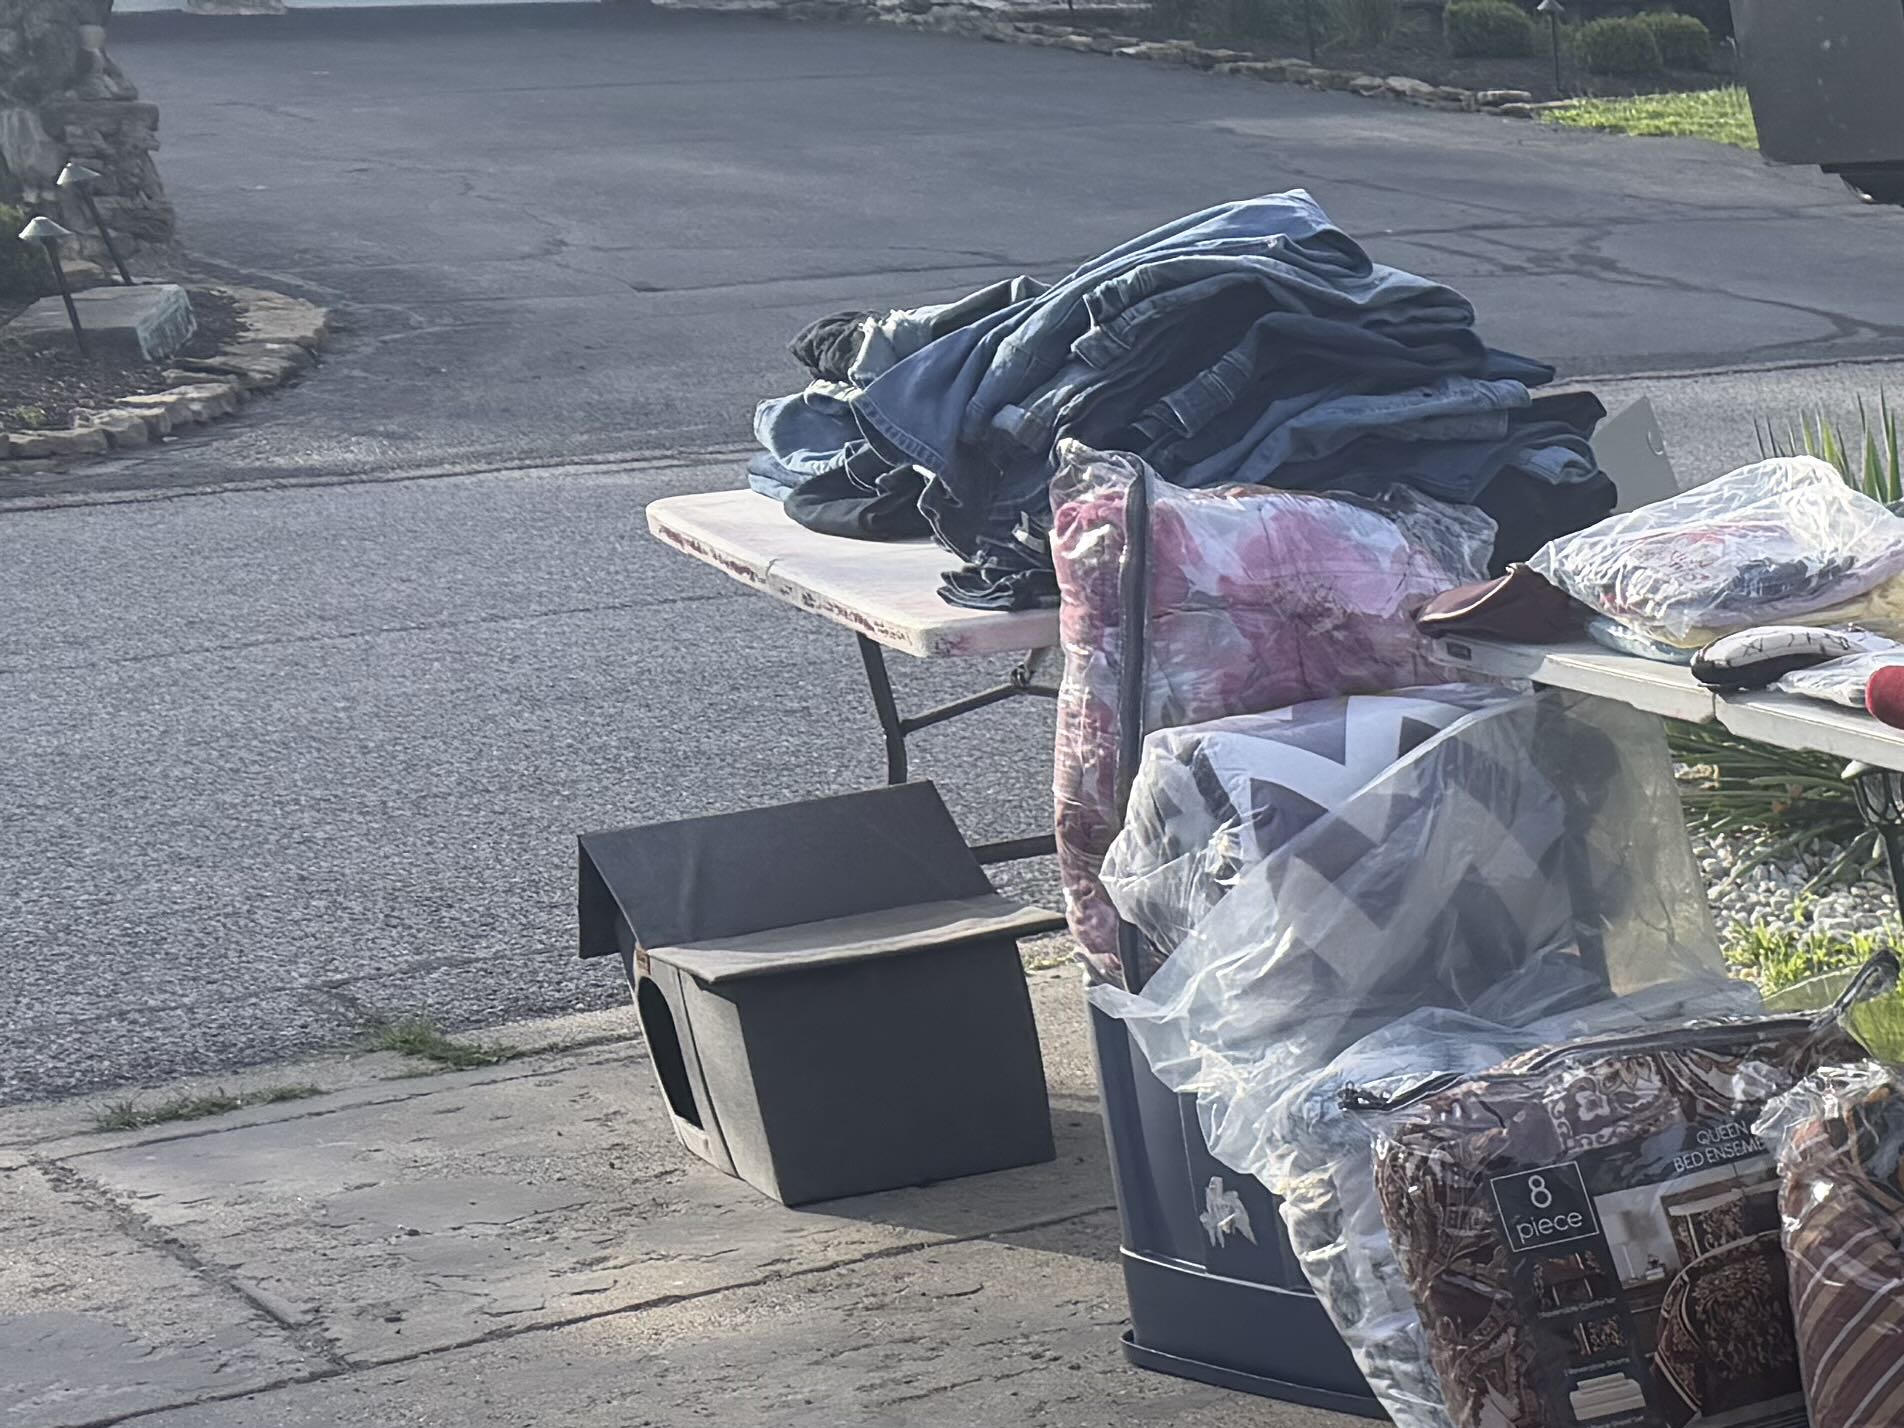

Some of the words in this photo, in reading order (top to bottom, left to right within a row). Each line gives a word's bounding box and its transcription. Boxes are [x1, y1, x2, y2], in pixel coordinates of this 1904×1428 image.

[1696, 1120, 1749, 1145] QUEEN
[1672, 1151, 1704, 1173] BED
[1528, 1174, 1552, 1209] 8
[1516, 1211, 1584, 1245] piece
